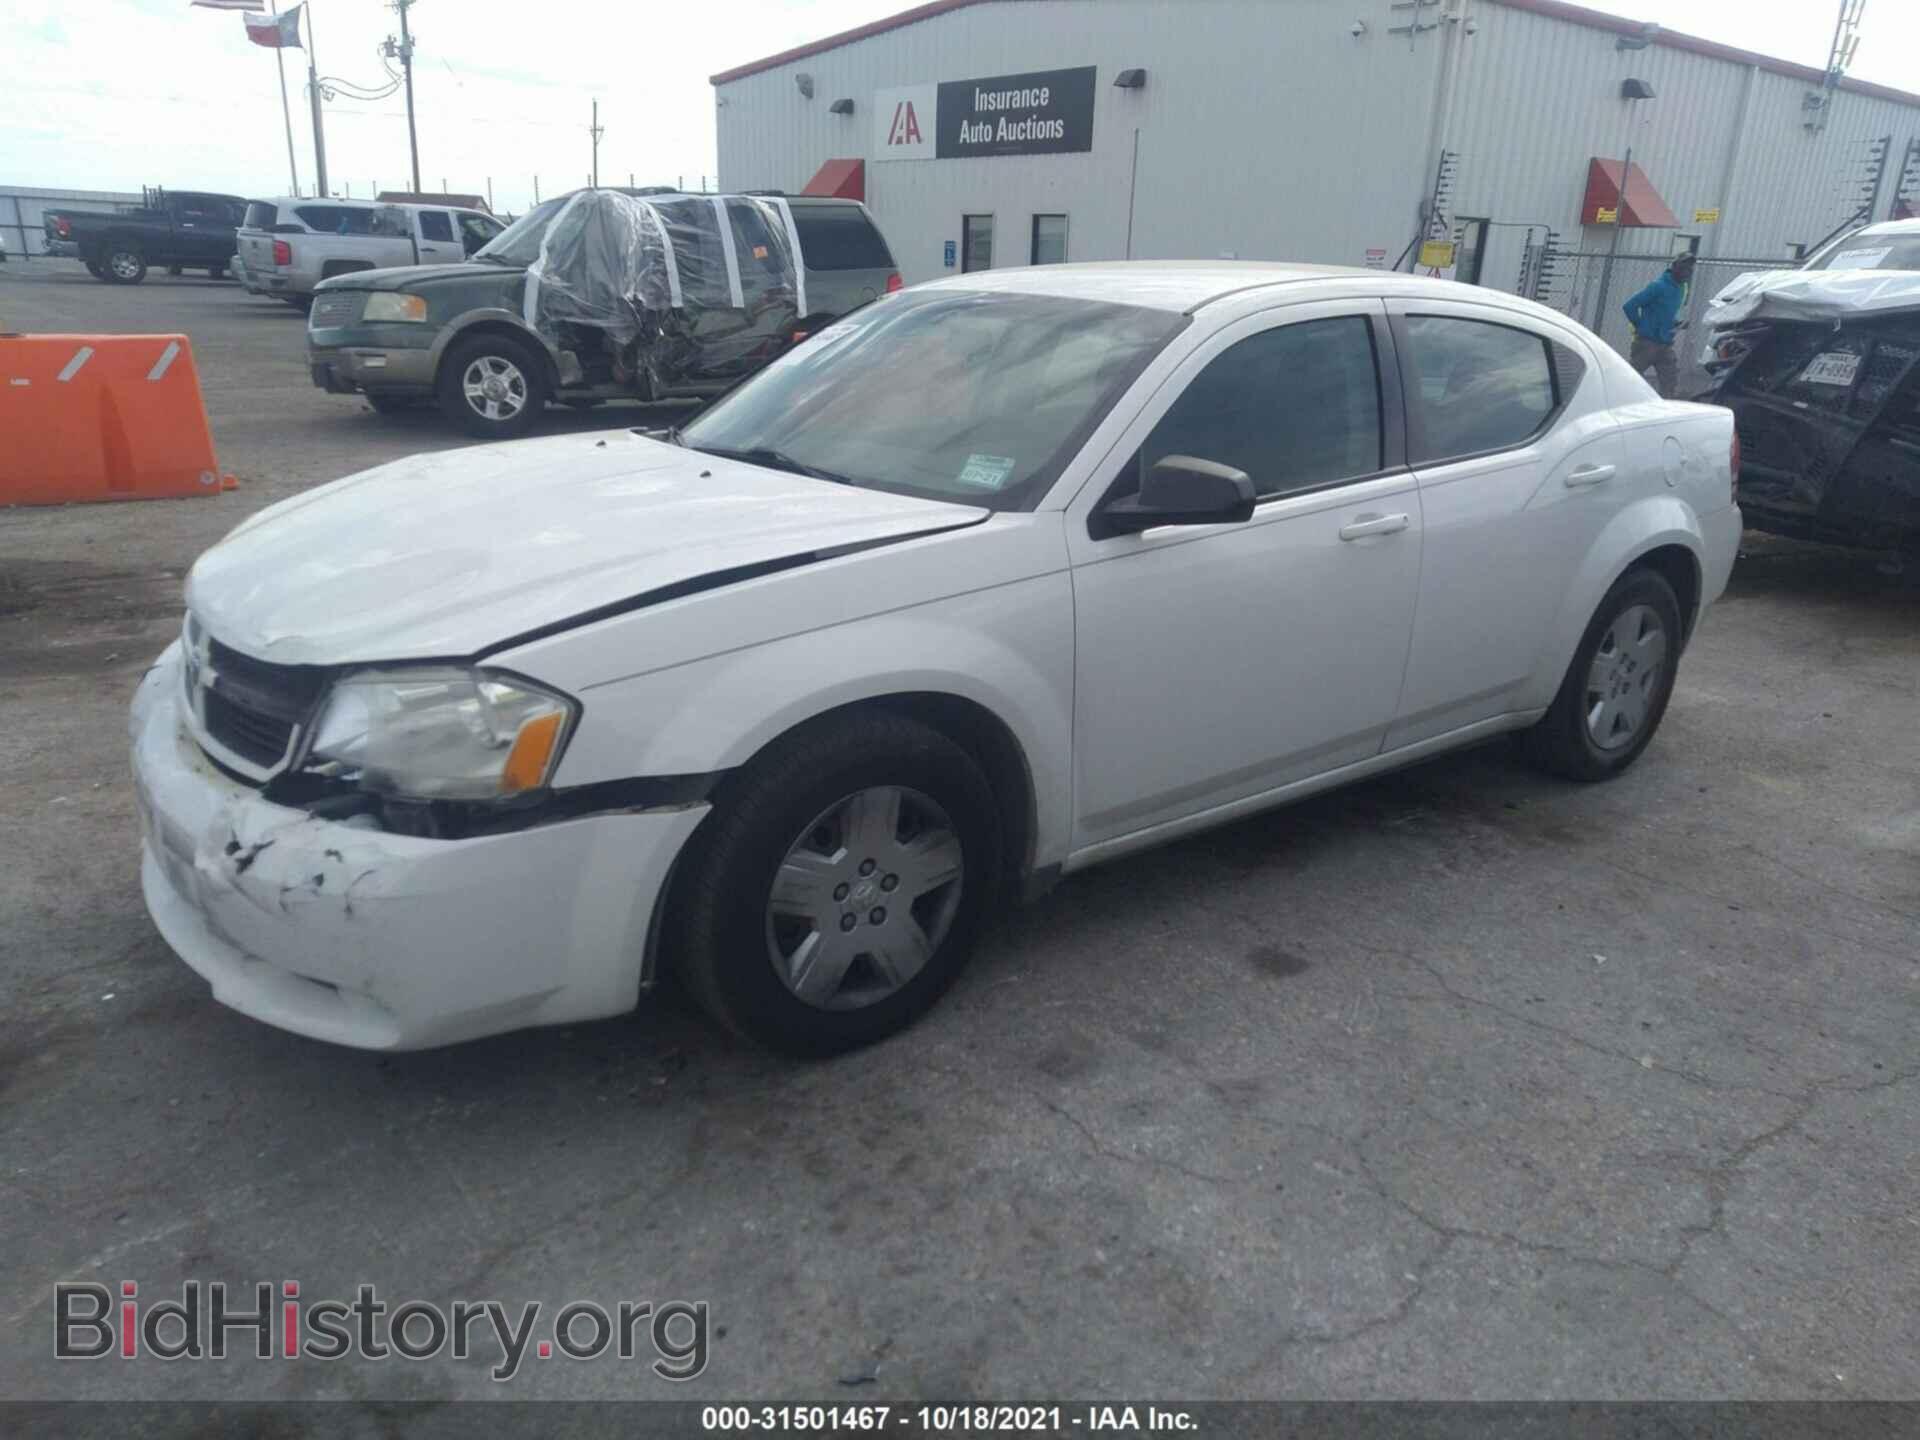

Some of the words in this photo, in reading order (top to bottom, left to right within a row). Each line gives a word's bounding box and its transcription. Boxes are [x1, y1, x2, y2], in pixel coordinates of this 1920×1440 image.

[974, 86, 1050, 112] Insurance
[959, 118, 993, 145] Auto
[996, 114, 1065, 143] Auctions
